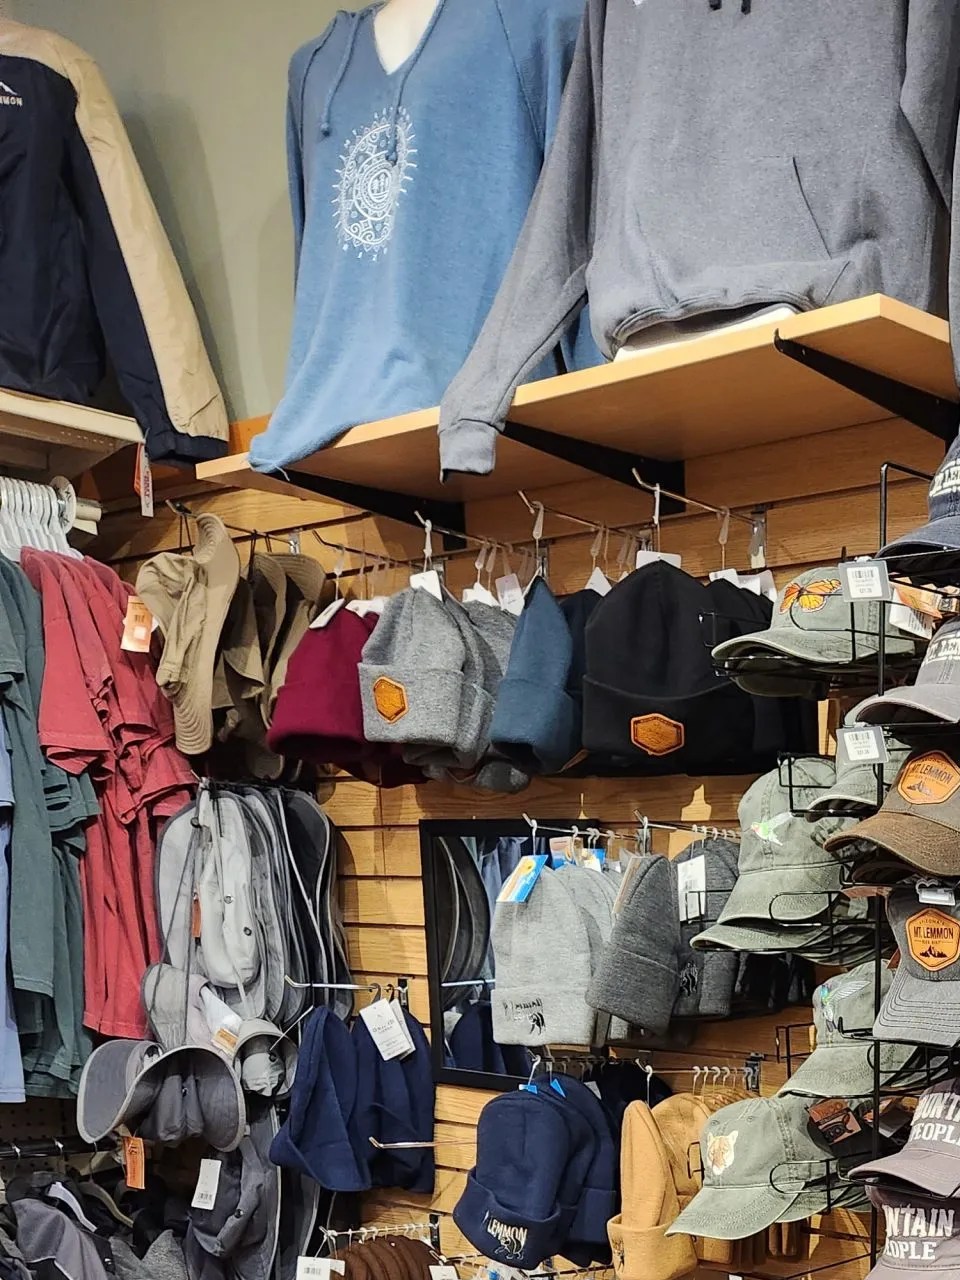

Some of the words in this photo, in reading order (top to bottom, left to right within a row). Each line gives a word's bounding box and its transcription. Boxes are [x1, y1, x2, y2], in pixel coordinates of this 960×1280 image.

[919, 765, 953, 784] LEMMON
[923, 927, 954, 939] LEMMON
[487, 1218, 528, 1245] LEMMON
